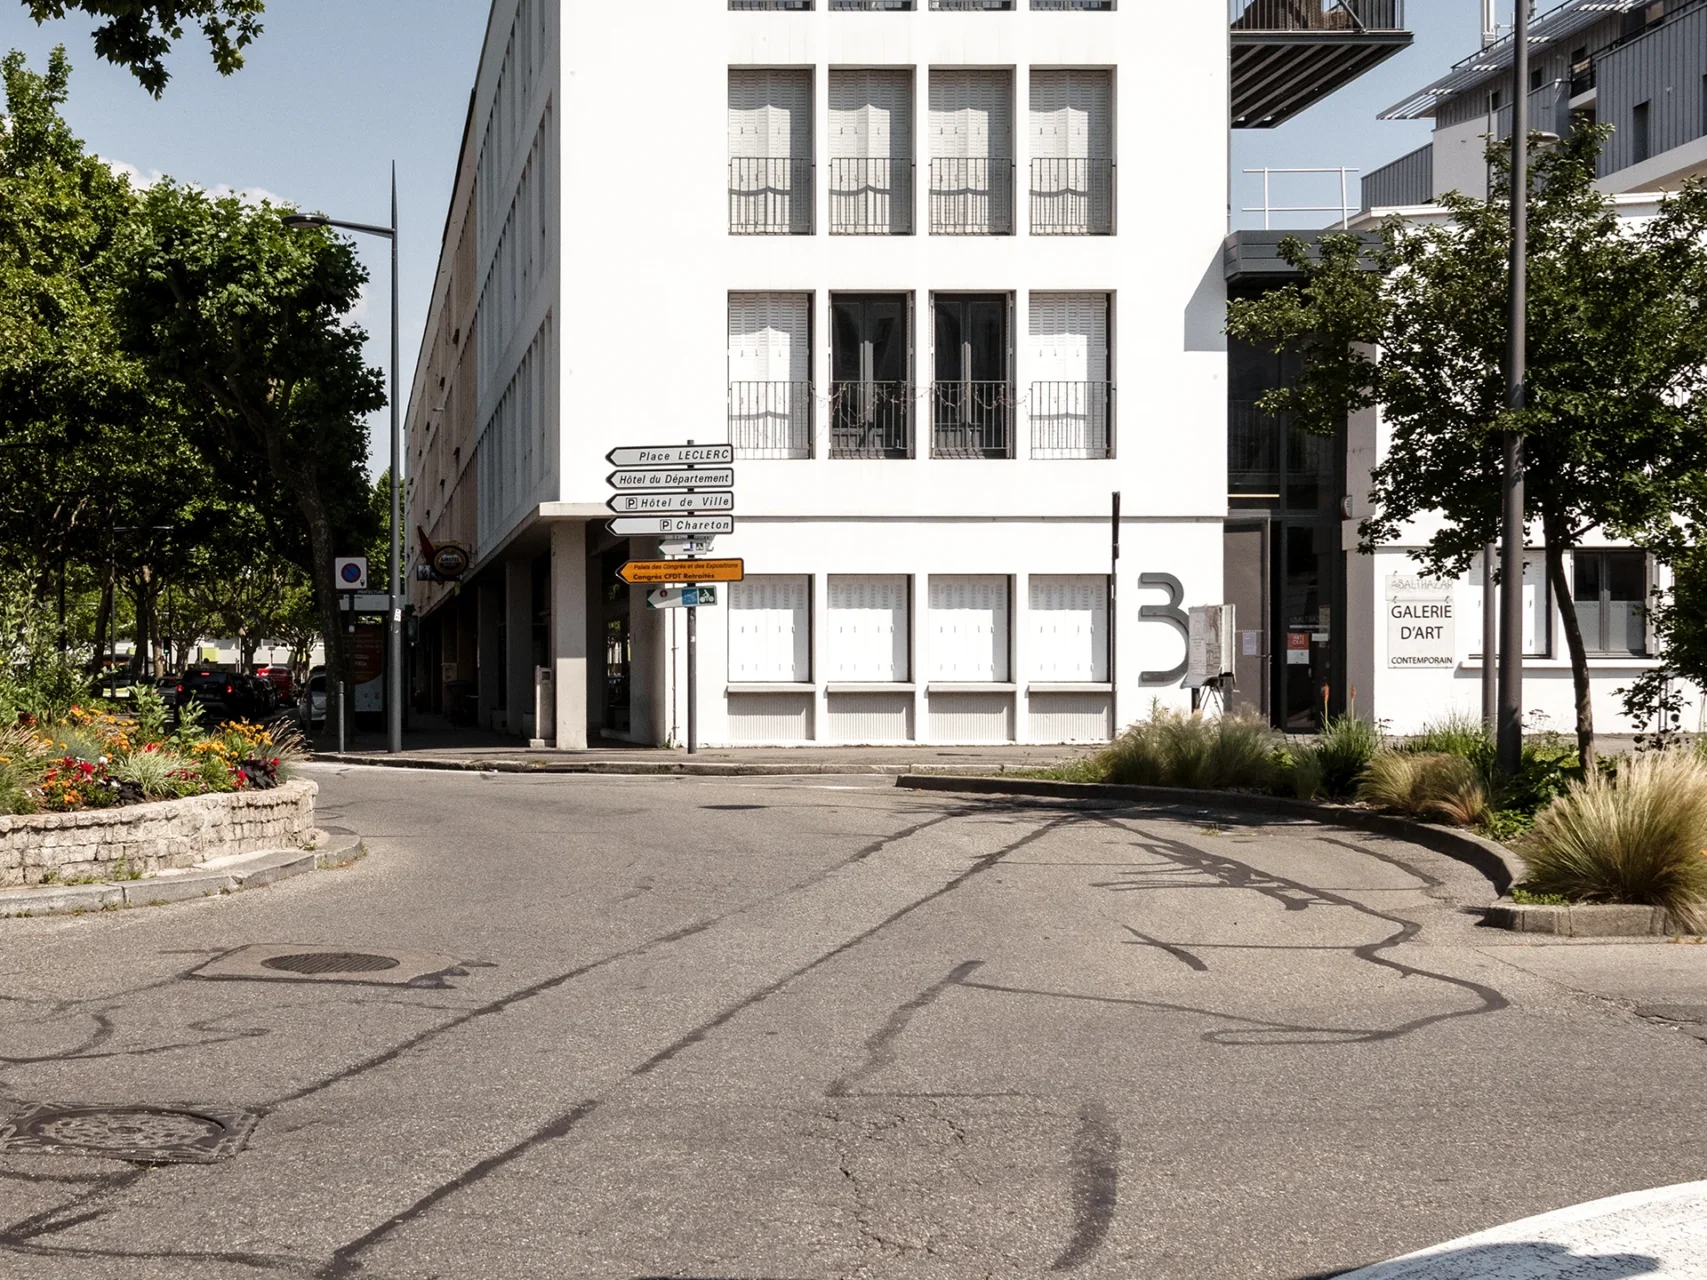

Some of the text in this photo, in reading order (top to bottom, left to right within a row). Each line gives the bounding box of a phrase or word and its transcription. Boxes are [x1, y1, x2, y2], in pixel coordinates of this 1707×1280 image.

[639, 449, 729, 461] Place LECLERC
[619, 473, 729, 485] Hôtel du Département
[627, 496, 729, 508] P Hôtel de Ville
[661, 520, 729, 530] P Chareton
[706, 562, 738, 570] Expositions
[633, 573, 662, 581] Congrès
[1391, 605, 1452, 618] GALERIE
[1138, 572, 1190, 687] 3
[1401, 626, 1443, 639] D'ART
[1391, 656, 1453, 664] CONTEMPORAIN
